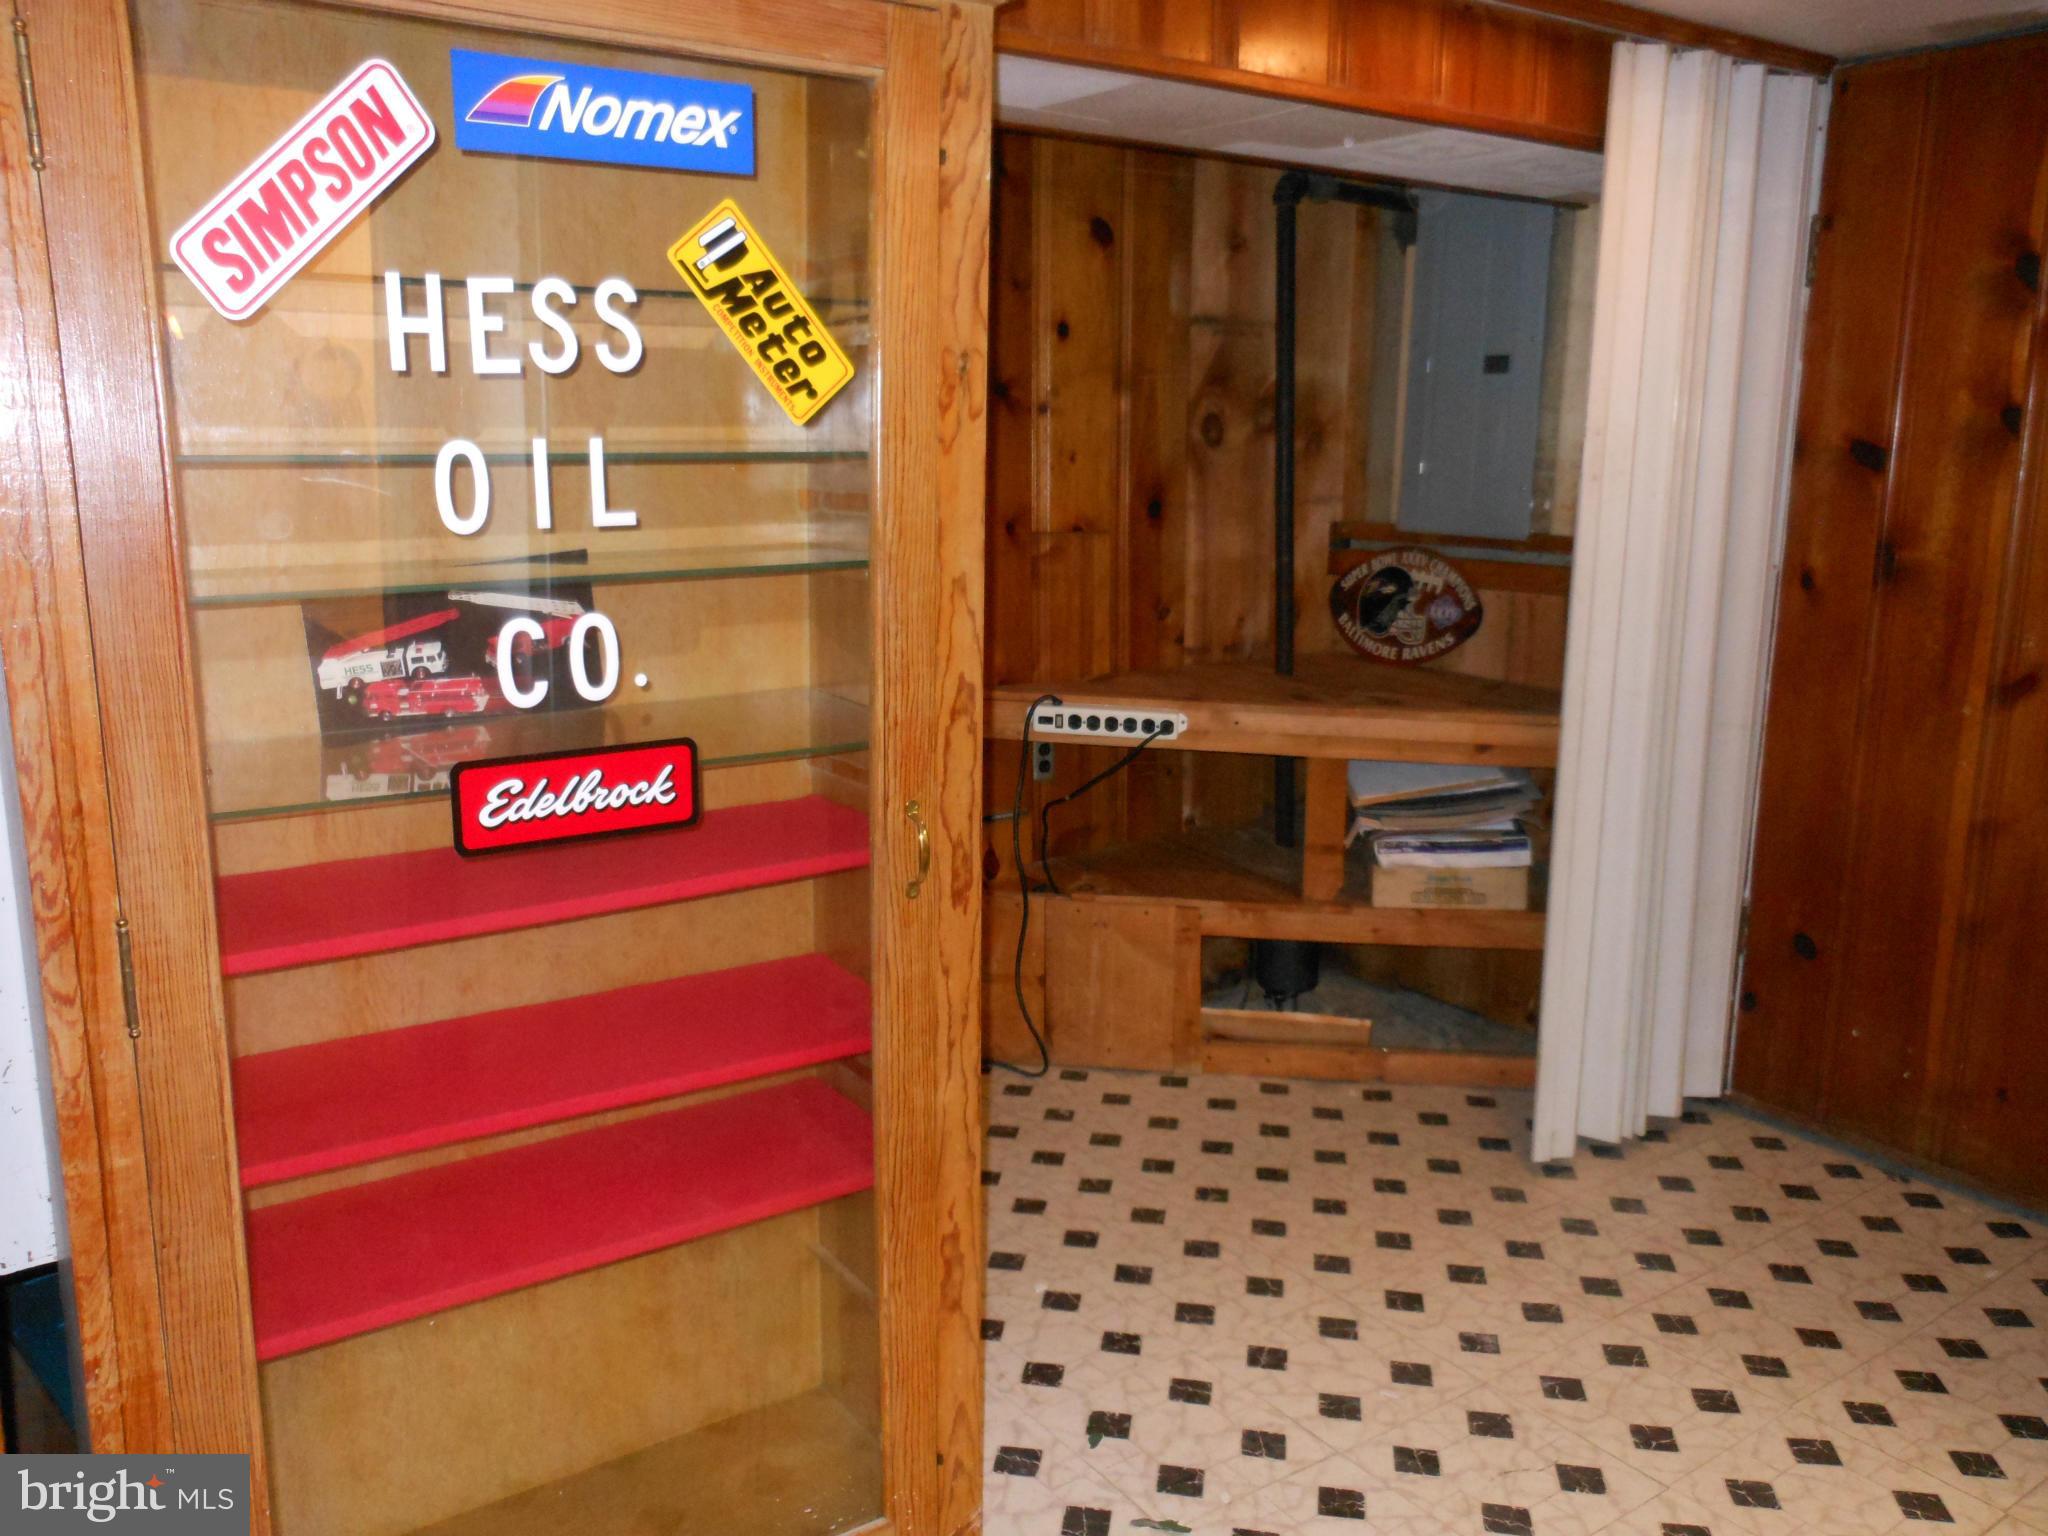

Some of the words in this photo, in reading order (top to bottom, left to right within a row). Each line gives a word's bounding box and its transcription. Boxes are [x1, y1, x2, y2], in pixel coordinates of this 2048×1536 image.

[539, 84, 741, 149] Nomex
[201, 84, 408, 292] SIMPSON
[384, 271, 644, 375] HESS
[702, 275, 819, 401] Meter
[712, 303, 754, 355] COMPETITION
[740, 269, 827, 368] Auto
[753, 359, 797, 412] INSTRUMENTS
[435, 438, 637, 535] OIL
[344, 664, 374, 675] HESS
[497, 612, 648, 709] CO.
[1338, 612, 1398, 660] BALTIMORE
[1402, 632, 1455, 661] RAVENS
[478, 764, 677, 828] Edelbrock
